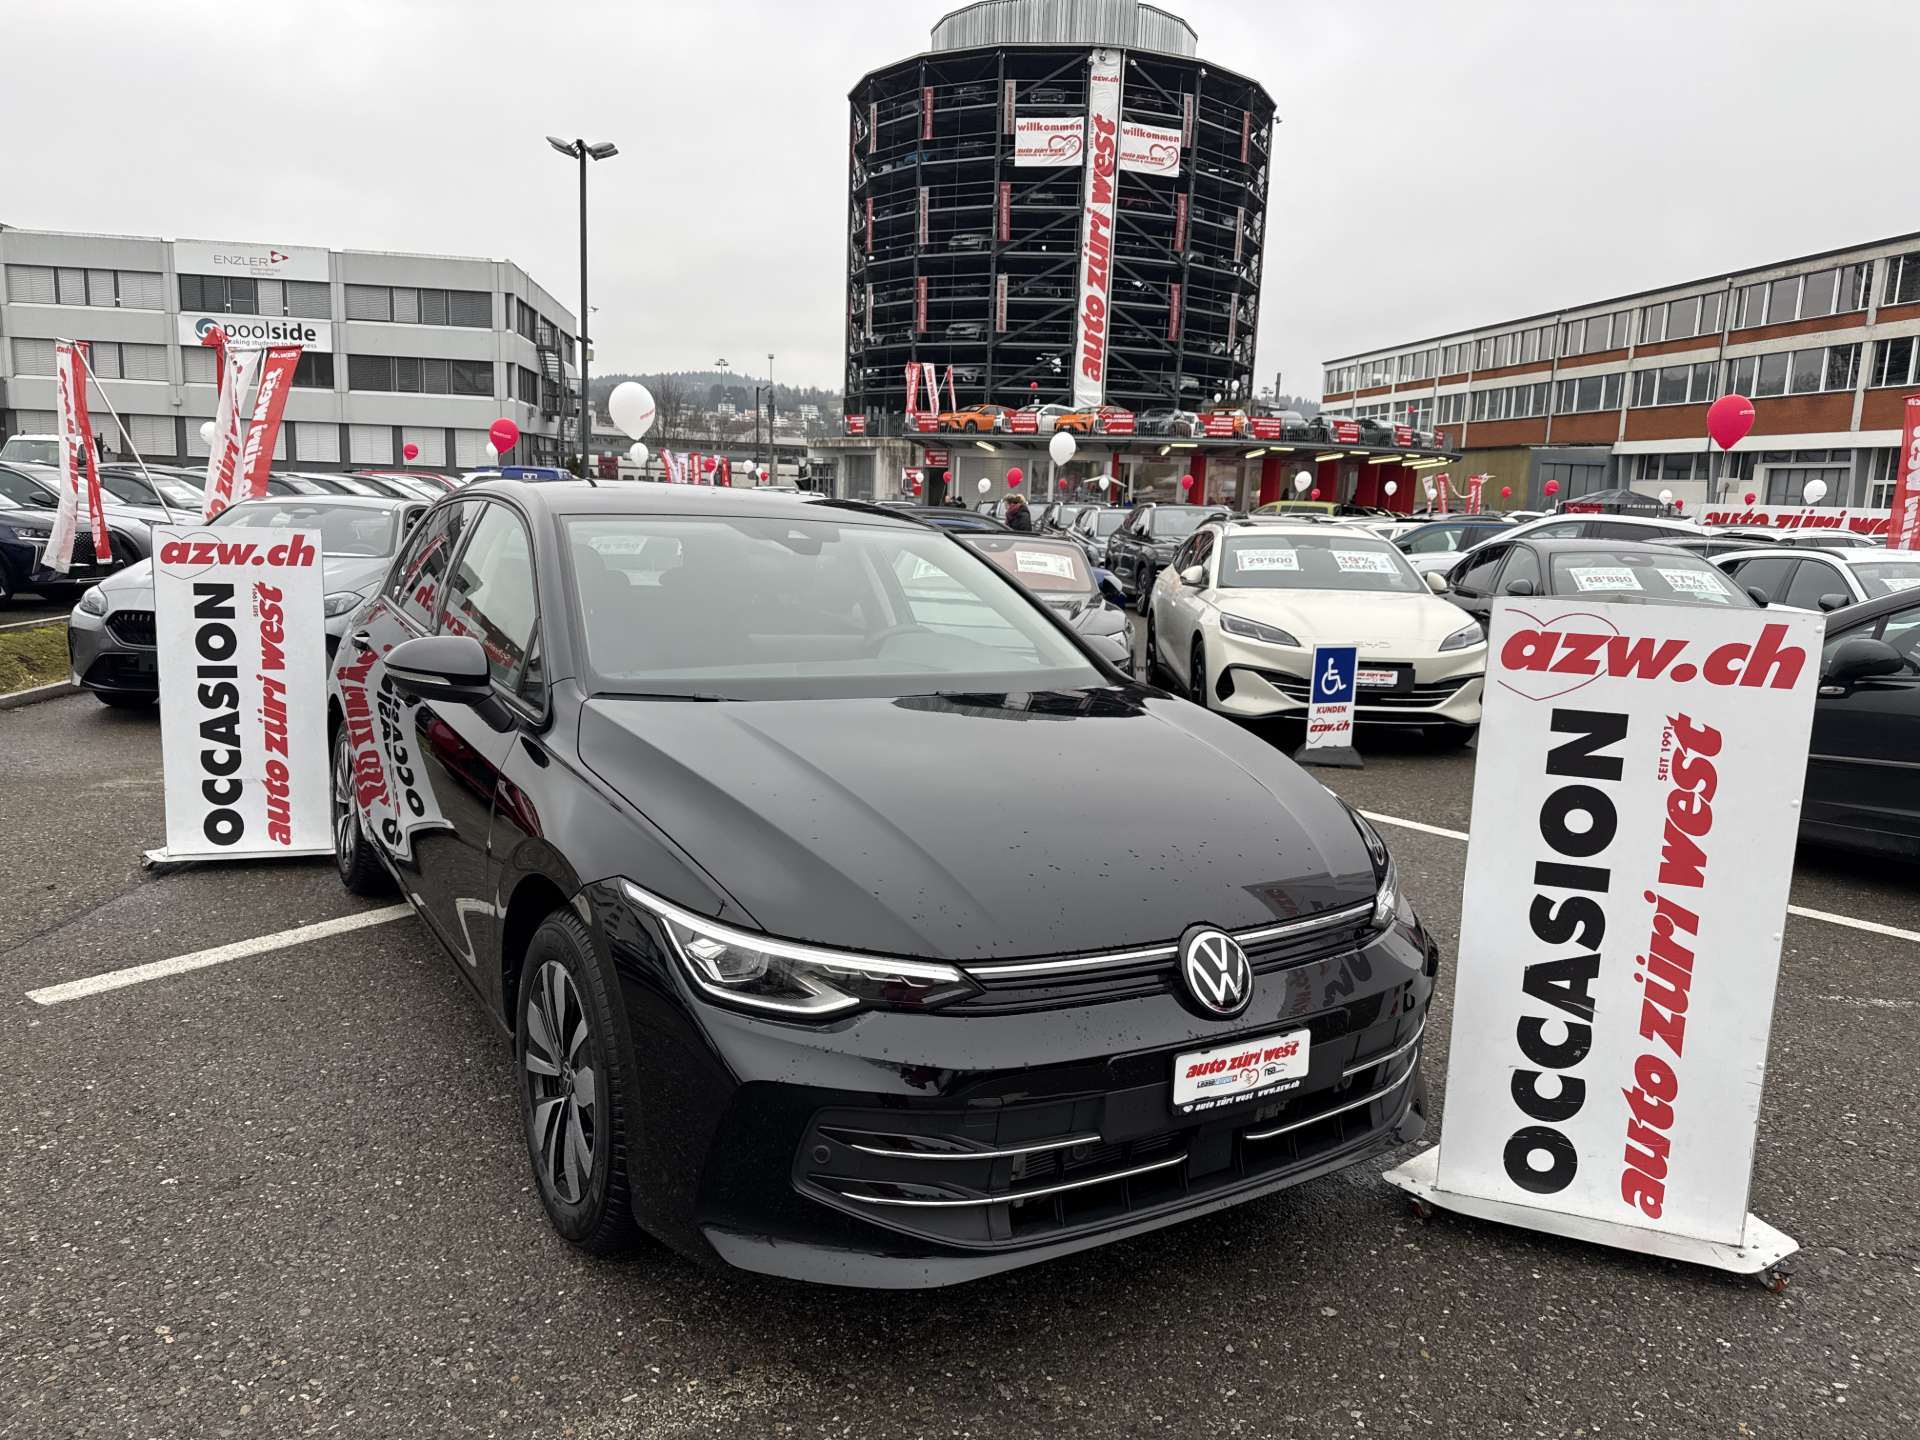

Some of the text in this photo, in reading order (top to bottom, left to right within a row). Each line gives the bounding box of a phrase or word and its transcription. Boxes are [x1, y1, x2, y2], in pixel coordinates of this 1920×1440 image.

[1091, 75, 1119, 83] azw.ch
[1017, 121, 1083, 132] willkommen
[1122, 127, 1180, 143] willkommen
[213, 254, 269, 267] ENZLER
[1081, 112, 1116, 382] auto züri west
[224, 321, 317, 341] poolside
[160, 533, 316, 567] azw.ch
[1500, 623, 1807, 690] azw.ch
[193, 583, 244, 846] OCCASION
[252, 581, 291, 846] auto züri west
[1310, 720, 1350, 733] azw.ch
[1316, 705, 1347, 714] KUNDEN
[1658, 726, 1673, 781] SEIT 1991
[1503, 707, 1630, 1194] OCCASION
[1620, 712, 1723, 1220] auto züri west
[1186, 1040, 1300, 1079] auto züri west
[1195, 1080, 1300, 1111] auto züri west www.azw.ch
